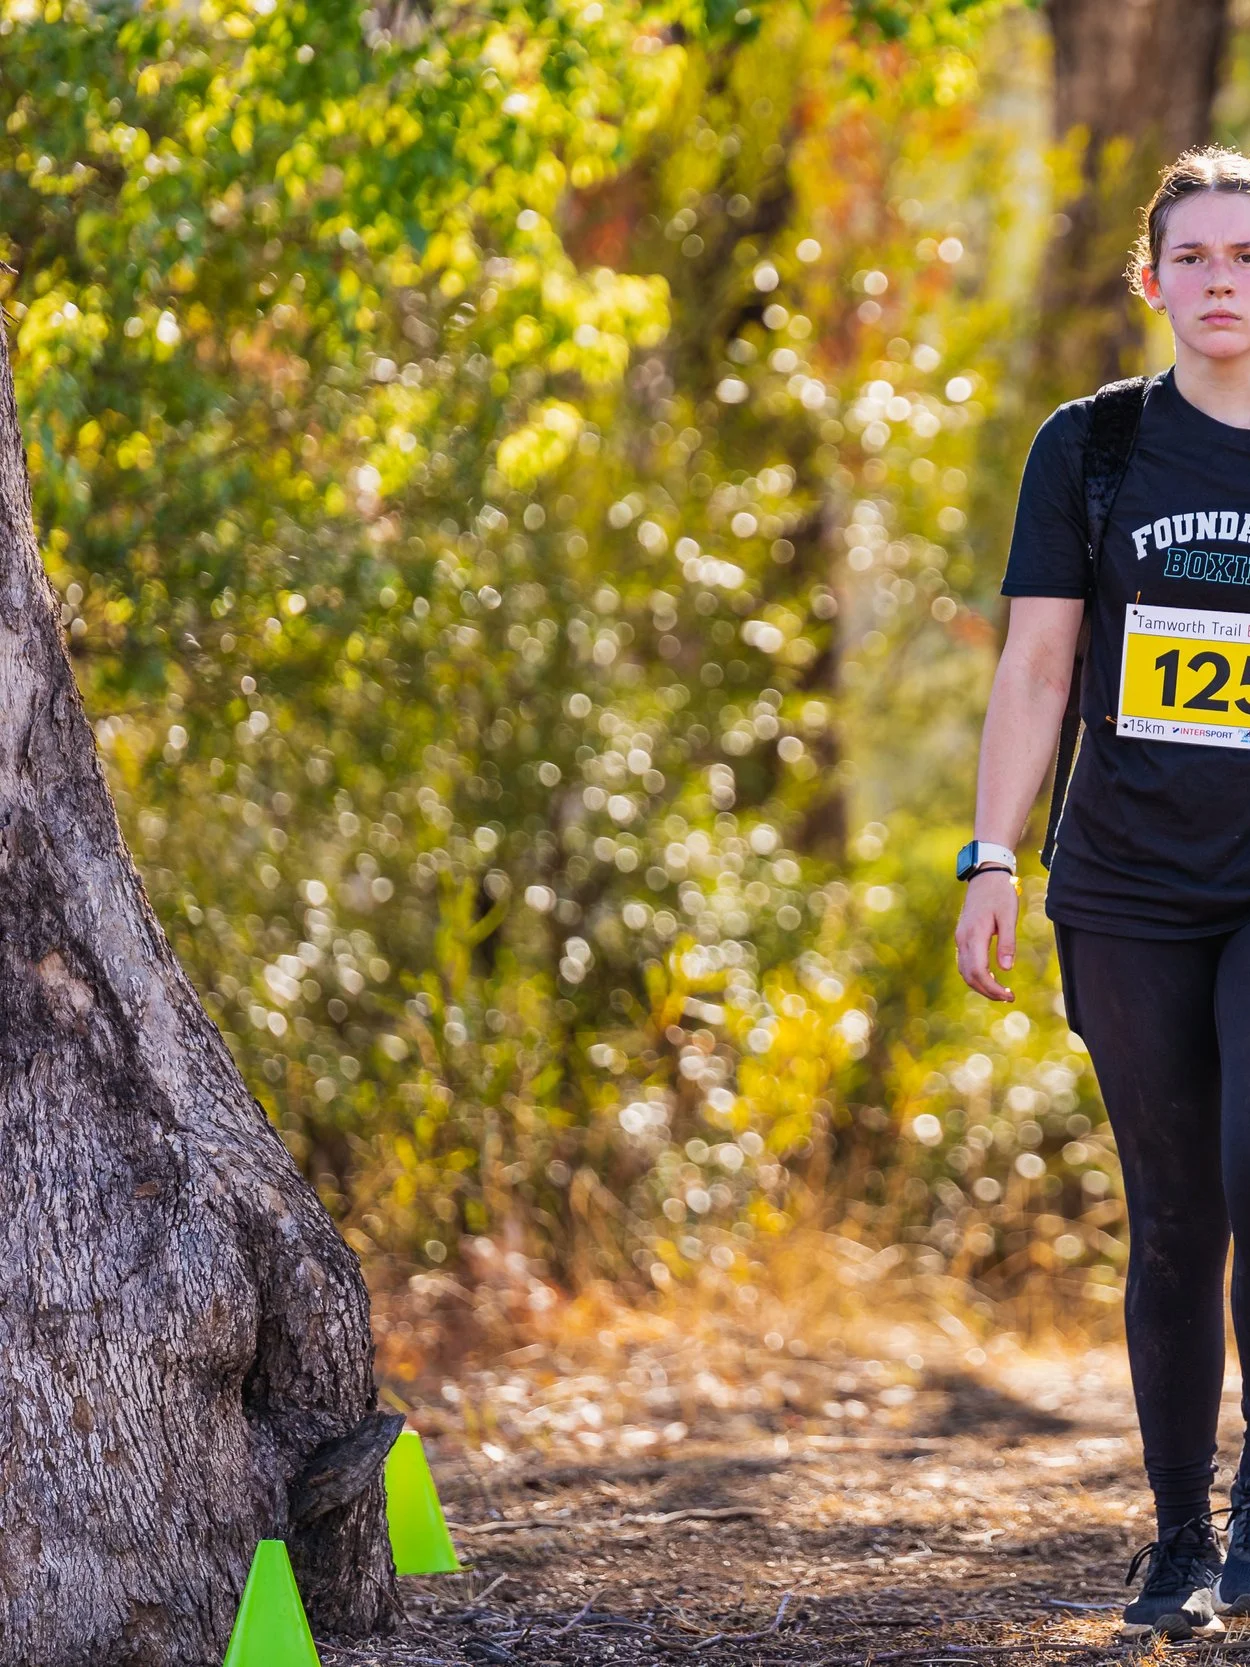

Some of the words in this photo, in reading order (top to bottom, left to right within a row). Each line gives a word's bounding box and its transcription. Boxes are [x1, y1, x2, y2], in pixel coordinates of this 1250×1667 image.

[1137, 615, 1206, 634] Tamworth
[1212, 621, 1242, 637] Trail
[1129, 718, 1165, 735] 15km
[1180, 727, 1233, 739] INTERSPORT
